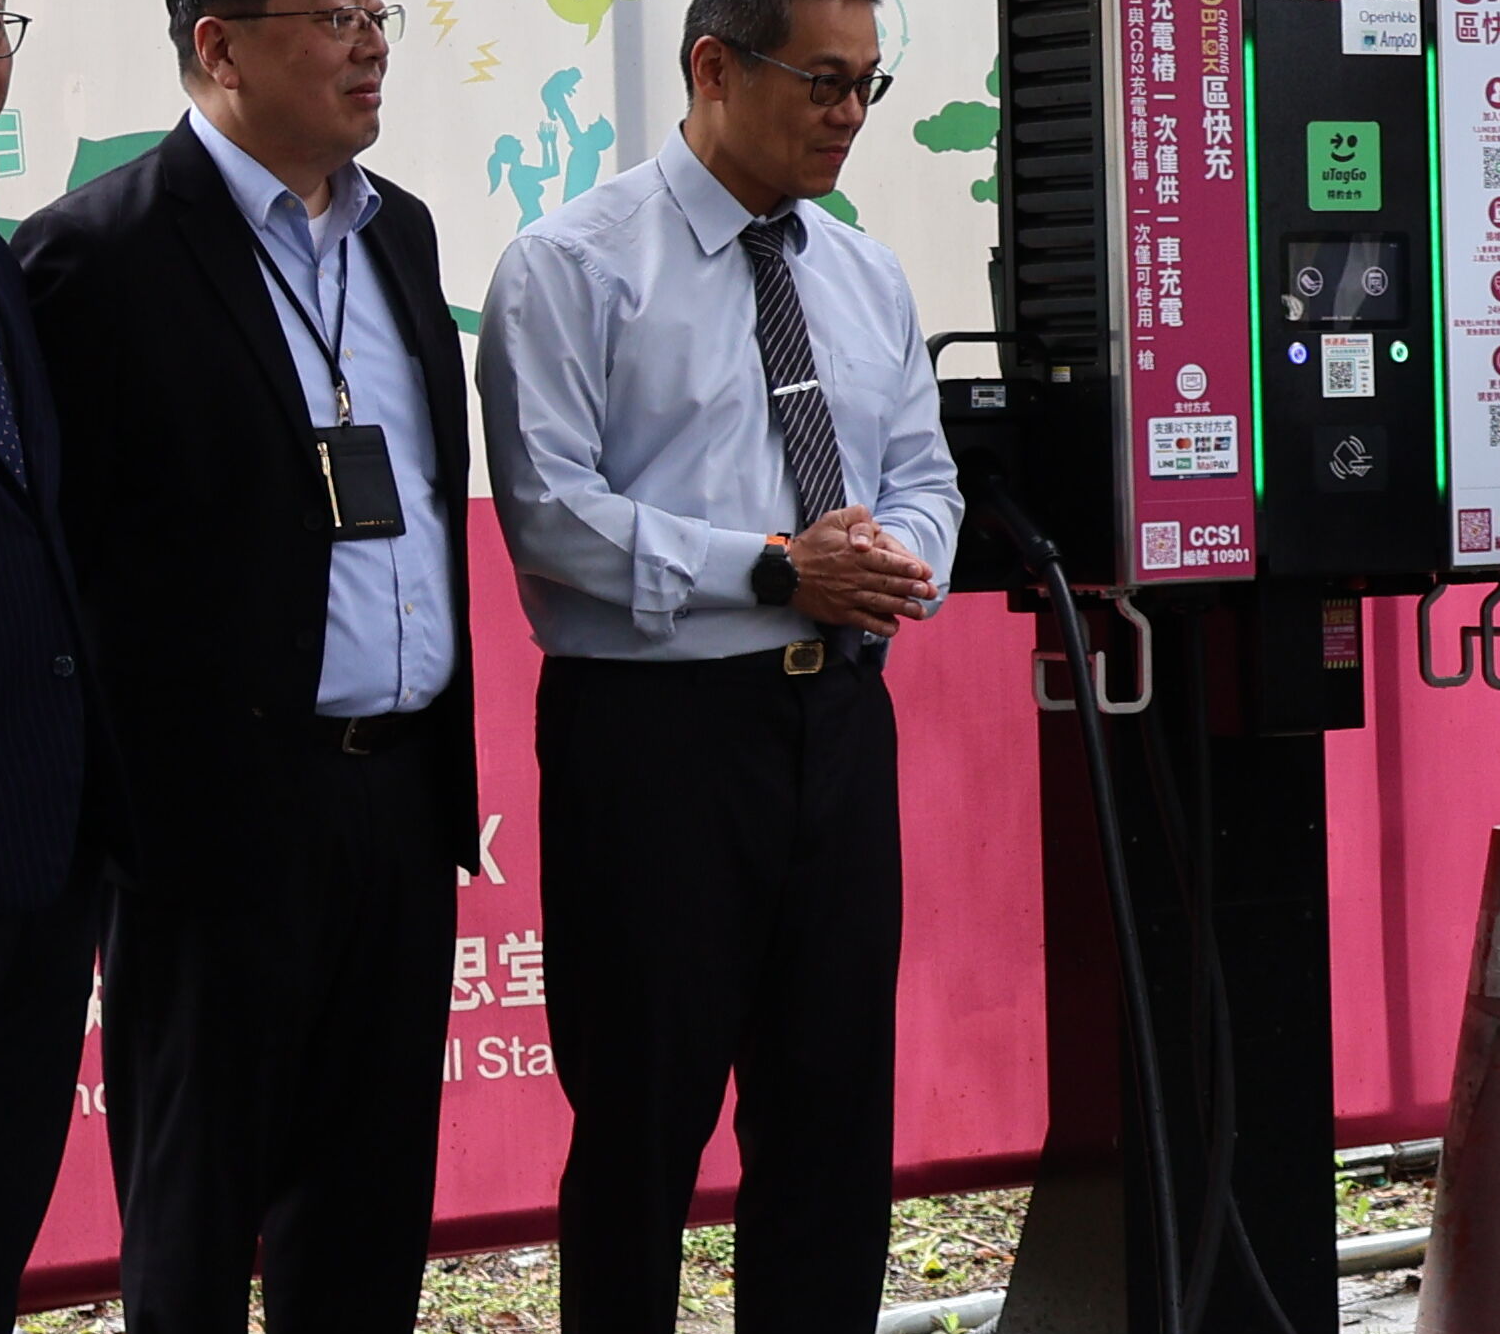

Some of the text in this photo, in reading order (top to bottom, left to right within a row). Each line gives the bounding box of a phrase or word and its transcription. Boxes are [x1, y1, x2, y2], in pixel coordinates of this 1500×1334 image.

[1217, 9, 1230, 74] CHARGING
[1202, 75, 1234, 181] 區快充
[1321, 168, 1367, 185] uTagGo
[1174, 400, 1212, 414] 支付方式
[1154, 420, 1234, 435] 支援以下支付方式
[1189, 524, 1241, 547] CCS1
[1212, 547, 1251, 564] 10901
